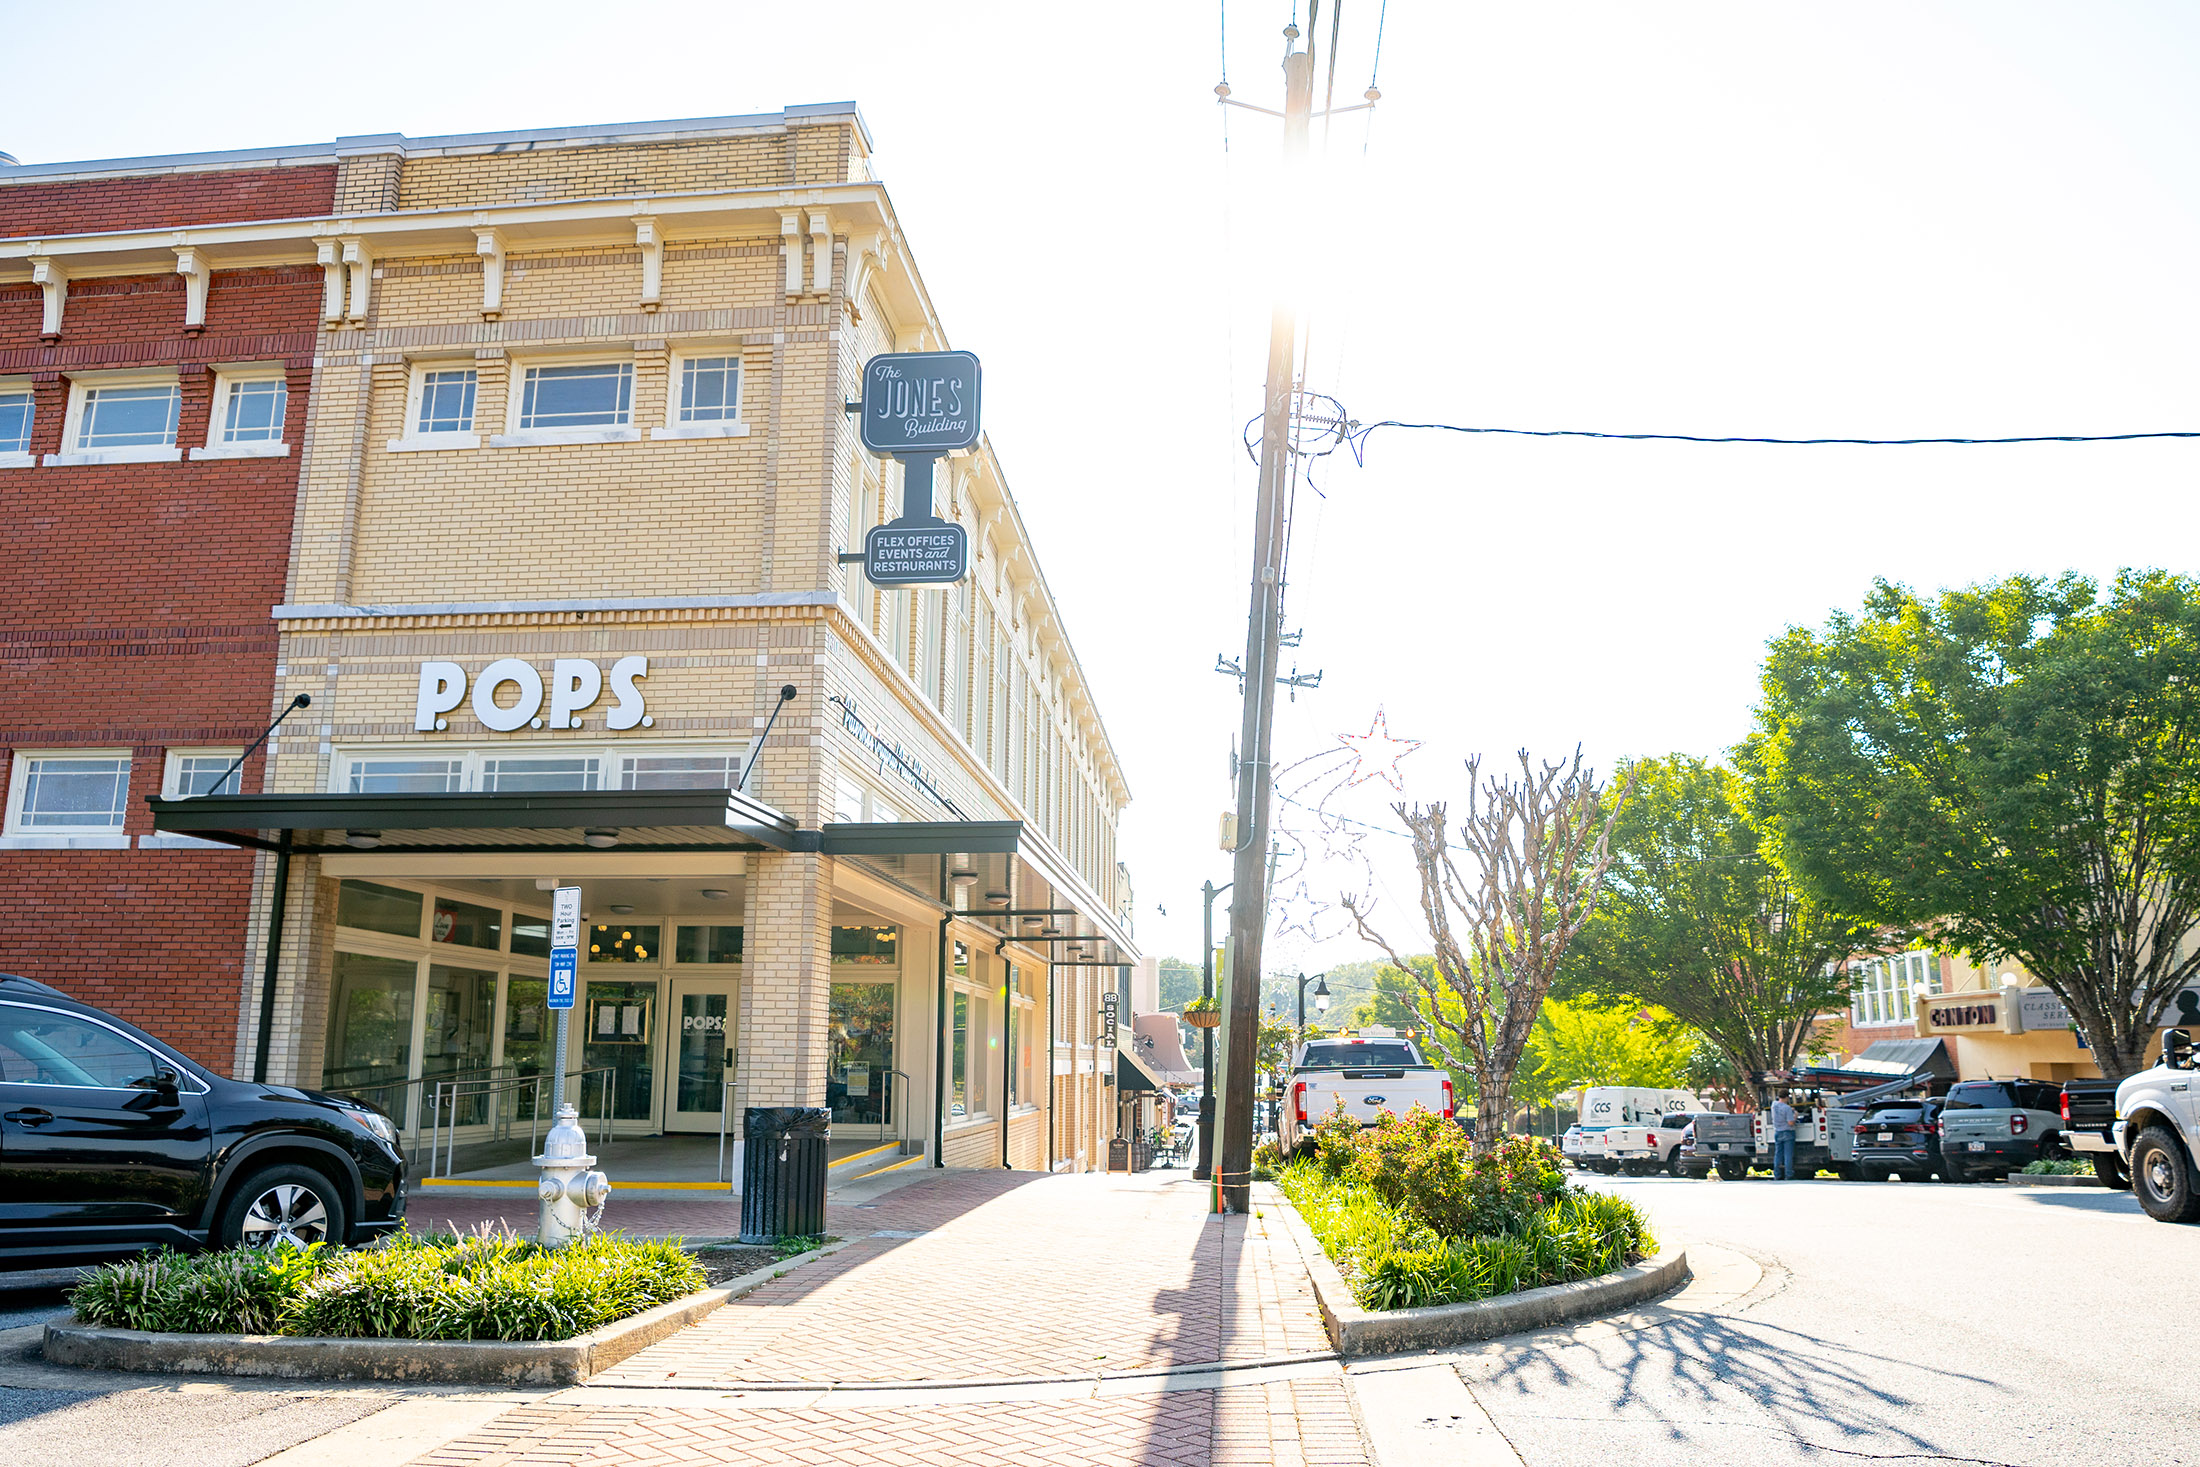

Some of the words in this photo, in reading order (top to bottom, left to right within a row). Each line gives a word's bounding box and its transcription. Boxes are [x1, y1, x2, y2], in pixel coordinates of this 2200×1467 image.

[875, 365, 902, 381] The
[877, 377, 962, 419] JONES
[904, 417, 967, 439] Building
[877, 537, 904, 547] FLEX
[907, 535, 955, 546] OFFICES
[878, 548, 923, 559] EVENTS
[924, 546, 950, 559] and
[873, 560, 957, 572] RESTAURANTS
[414, 655, 654, 732] P.O.P.S.
[1104, 994, 1117, 1002] 88
[2024, 1002, 2062, 1011] CLASSI
[1929, 1004, 1996, 1027] CANTON
[1106, 1004, 1115, 1047] SOCIAL
[1367, 1096, 1383, 1104] Ford
[1668, 1100, 1686, 1111] CCS
[1594, 1102, 1611, 1113] CCS
